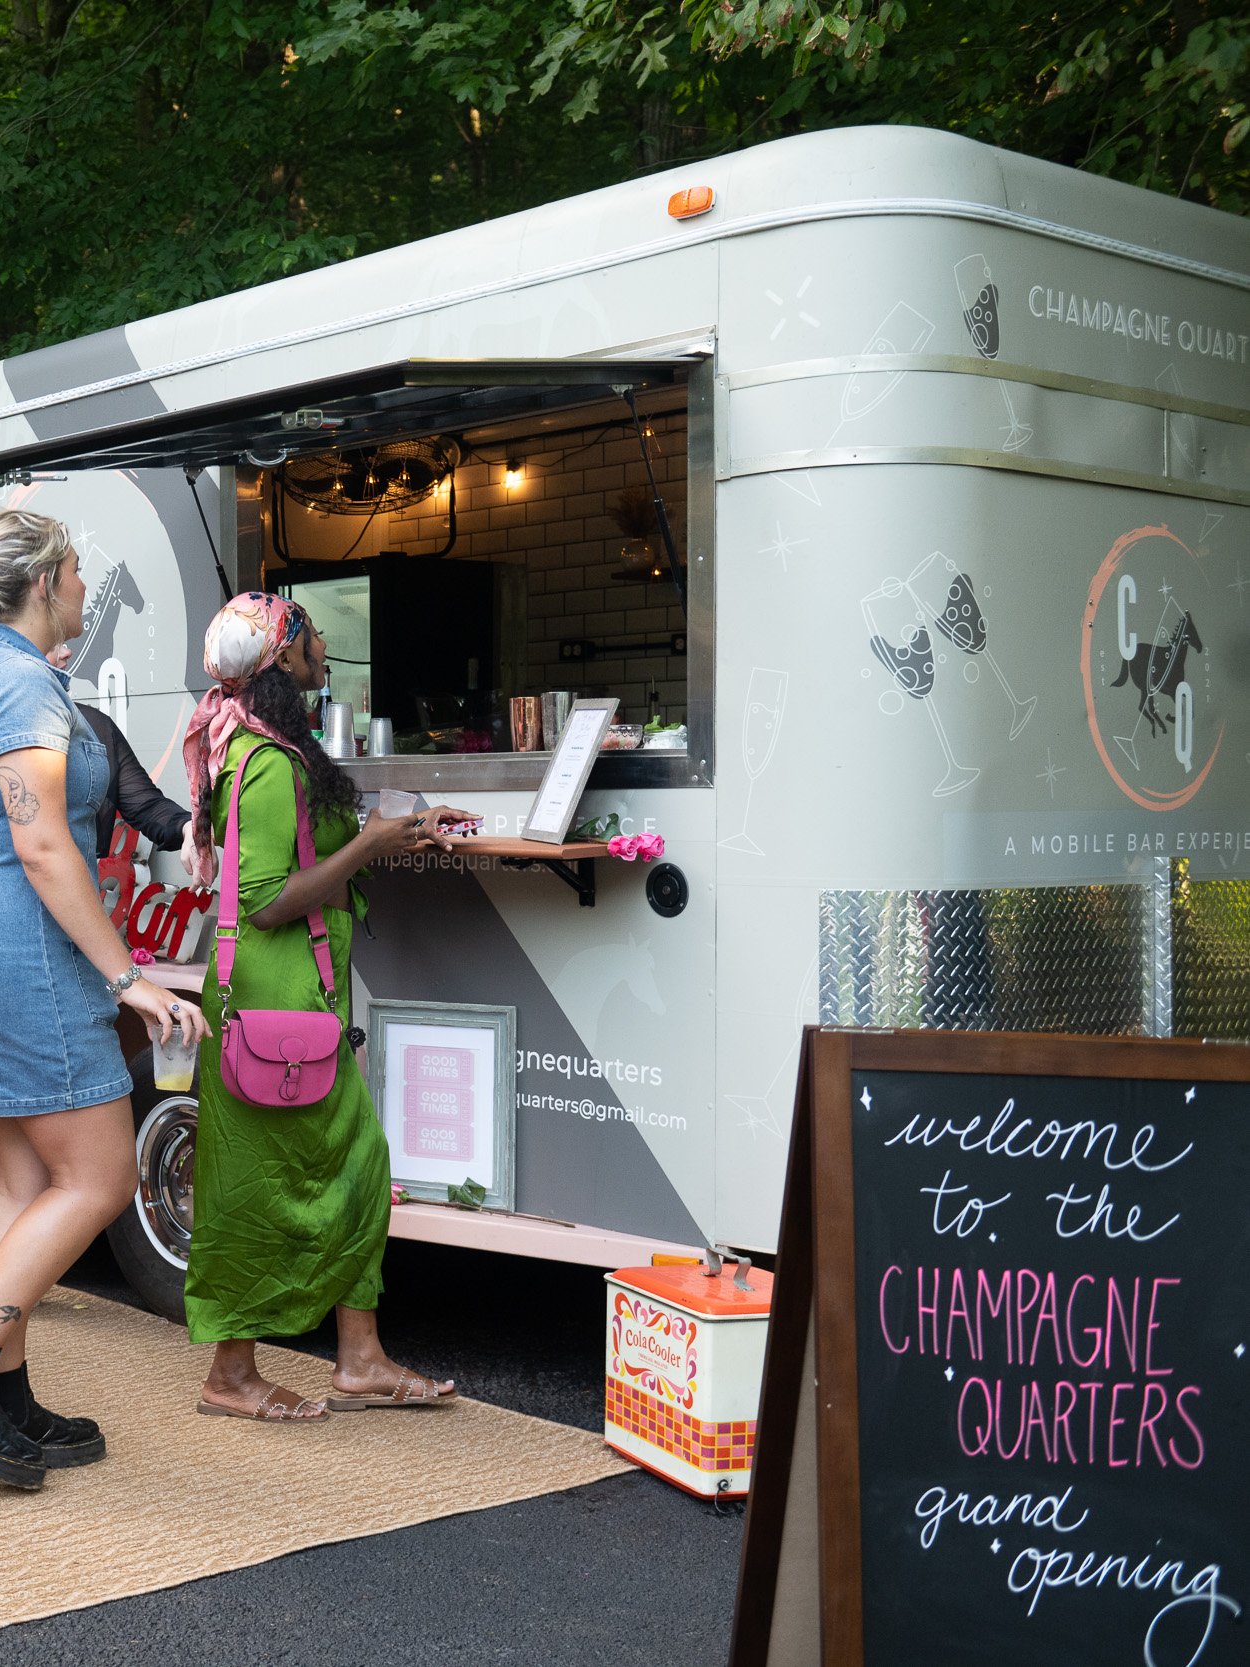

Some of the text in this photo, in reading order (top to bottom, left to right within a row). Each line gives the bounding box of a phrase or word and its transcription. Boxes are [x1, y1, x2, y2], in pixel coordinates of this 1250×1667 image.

[1028, 285, 1172, 347] CHAMPAGNE
[1117, 574, 1137, 661] C
[1175, 681, 1193, 774] Q
[1004, 837, 1017, 855] A
[1031, 834, 1115, 854] MOBILE
[1128, 833, 1165, 852] BAR
[420, 1066, 458, 1078] TIMES
[422, 1055, 457, 1067] GOOD
[420, 1102, 458, 1115] TIMES
[421, 1091, 457, 1104] GOOD
[419, 1139, 458, 1151] TIMES
[420, 1128, 456, 1140] GOOD
[884, 1098, 1194, 1172] welcome
[1045, 1183, 1180, 1241] the
[879, 1264, 1182, 1376] CHAMPAGNE
[956, 1377, 1205, 1470] QUARTERS
[914, 1485, 1090, 1550] grand
[1006, 1538, 1242, 1667] opening
